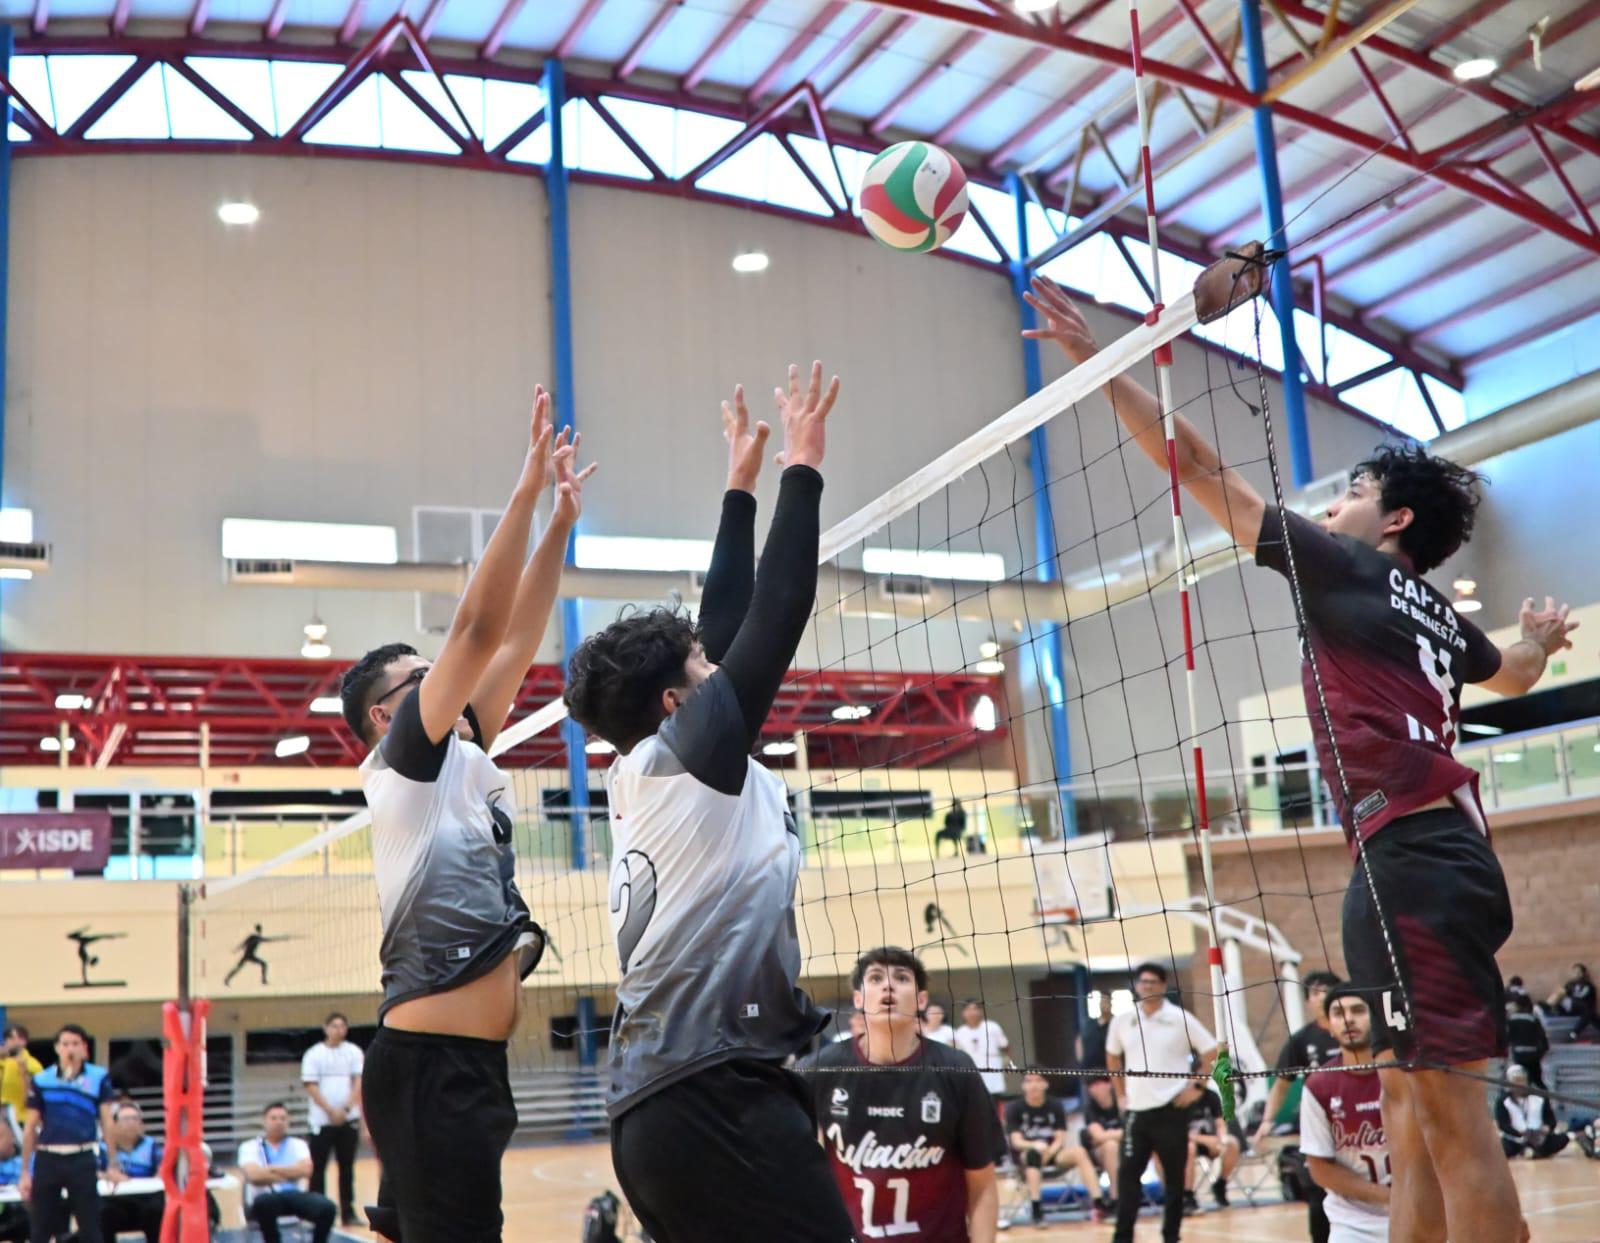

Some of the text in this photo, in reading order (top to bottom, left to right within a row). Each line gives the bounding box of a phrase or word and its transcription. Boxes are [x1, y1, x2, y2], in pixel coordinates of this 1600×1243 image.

[1391, 594, 1409, 615] DE
[38, 828, 93, 852] ISDE
[1382, 991, 1406, 1031] 4
[867, 1106, 905, 1118] IMDEC
[853, 1177, 921, 1239] 11
